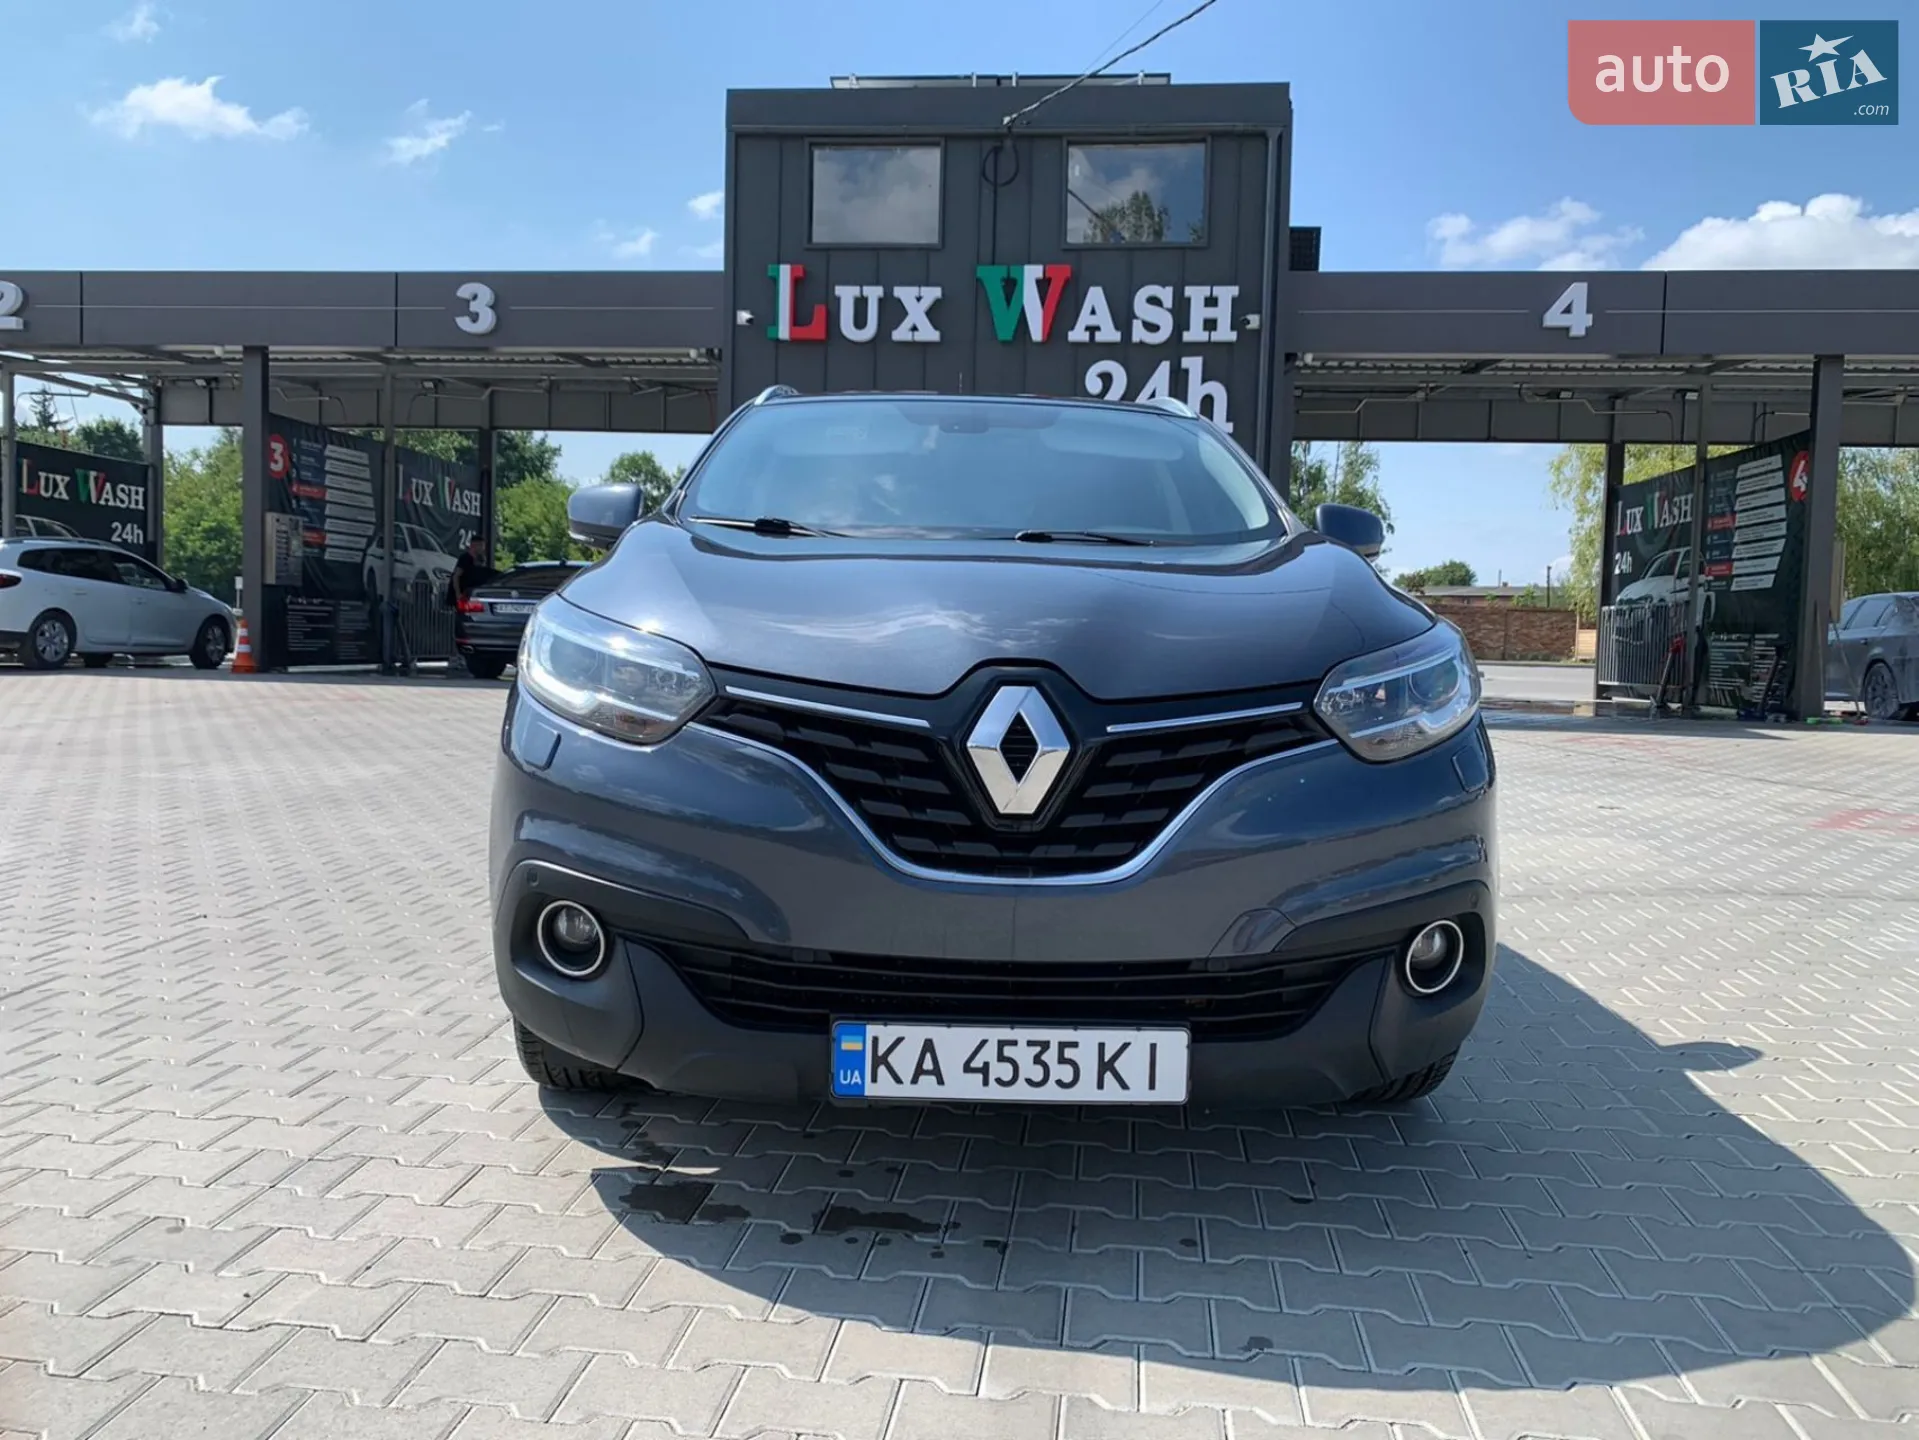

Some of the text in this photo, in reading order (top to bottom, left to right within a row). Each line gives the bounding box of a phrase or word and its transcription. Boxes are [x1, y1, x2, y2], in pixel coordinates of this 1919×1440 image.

[454, 282, 497, 335] 3
[1542, 282, 1593, 337] 4
[270, 441, 284, 472] 3
[1793, 460, 1808, 492] 4
[111, 521, 143, 544] 24h
[1614, 551, 1633, 576] 24h
[840, 1070, 862, 1085] UA
[871, 1036, 1157, 1091] KA 4535 KI
